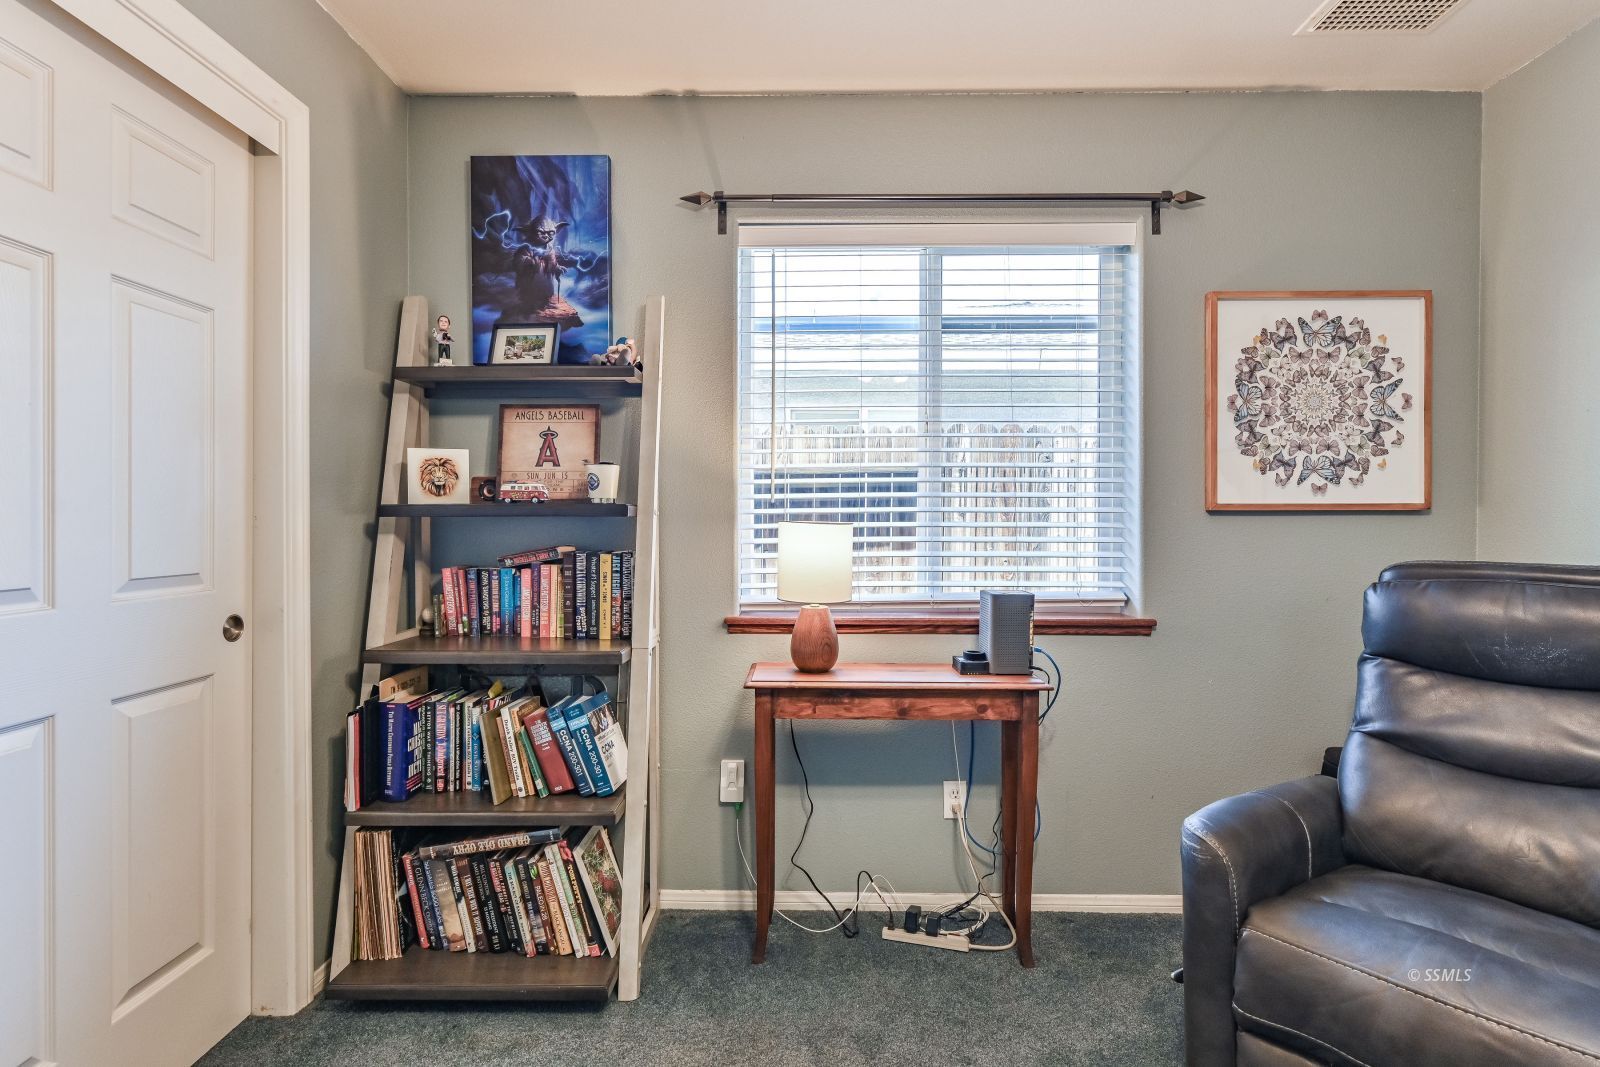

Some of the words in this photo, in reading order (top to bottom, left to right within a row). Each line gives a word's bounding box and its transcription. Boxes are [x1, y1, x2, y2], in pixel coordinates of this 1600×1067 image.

[515, 411, 544, 421] ANGELS
[548, 411, 585, 421] BASEBALL
[527, 472, 539, 480] SUN
[544, 472, 556, 480] JUN
[561, 472, 568, 480] 15
[612, 556, 620, 570] JACK
[612, 573, 620, 596] HIGGINS
[622, 621, 631, 636] Origin
[503, 719, 511, 735] Death
[506, 736, 514, 752] Valley
[559, 729, 573, 752] CCNA
[568, 751, 583, 777] 200-301
[579, 727, 594, 751] CCNA
[588, 750, 604, 778] 200-301
[452, 843, 477, 856] OPRY
[477, 840, 496, 852] OLE
[497, 835, 531, 849] GRAND
[567, 864, 576, 881] TOM
[413, 867, 427, 893] GLENN
[420, 892, 431, 911] BECK
[481, 874, 491, 896] CLINTON
[571, 880, 583, 904] PETTY
[533, 885, 546, 905] PALEO
